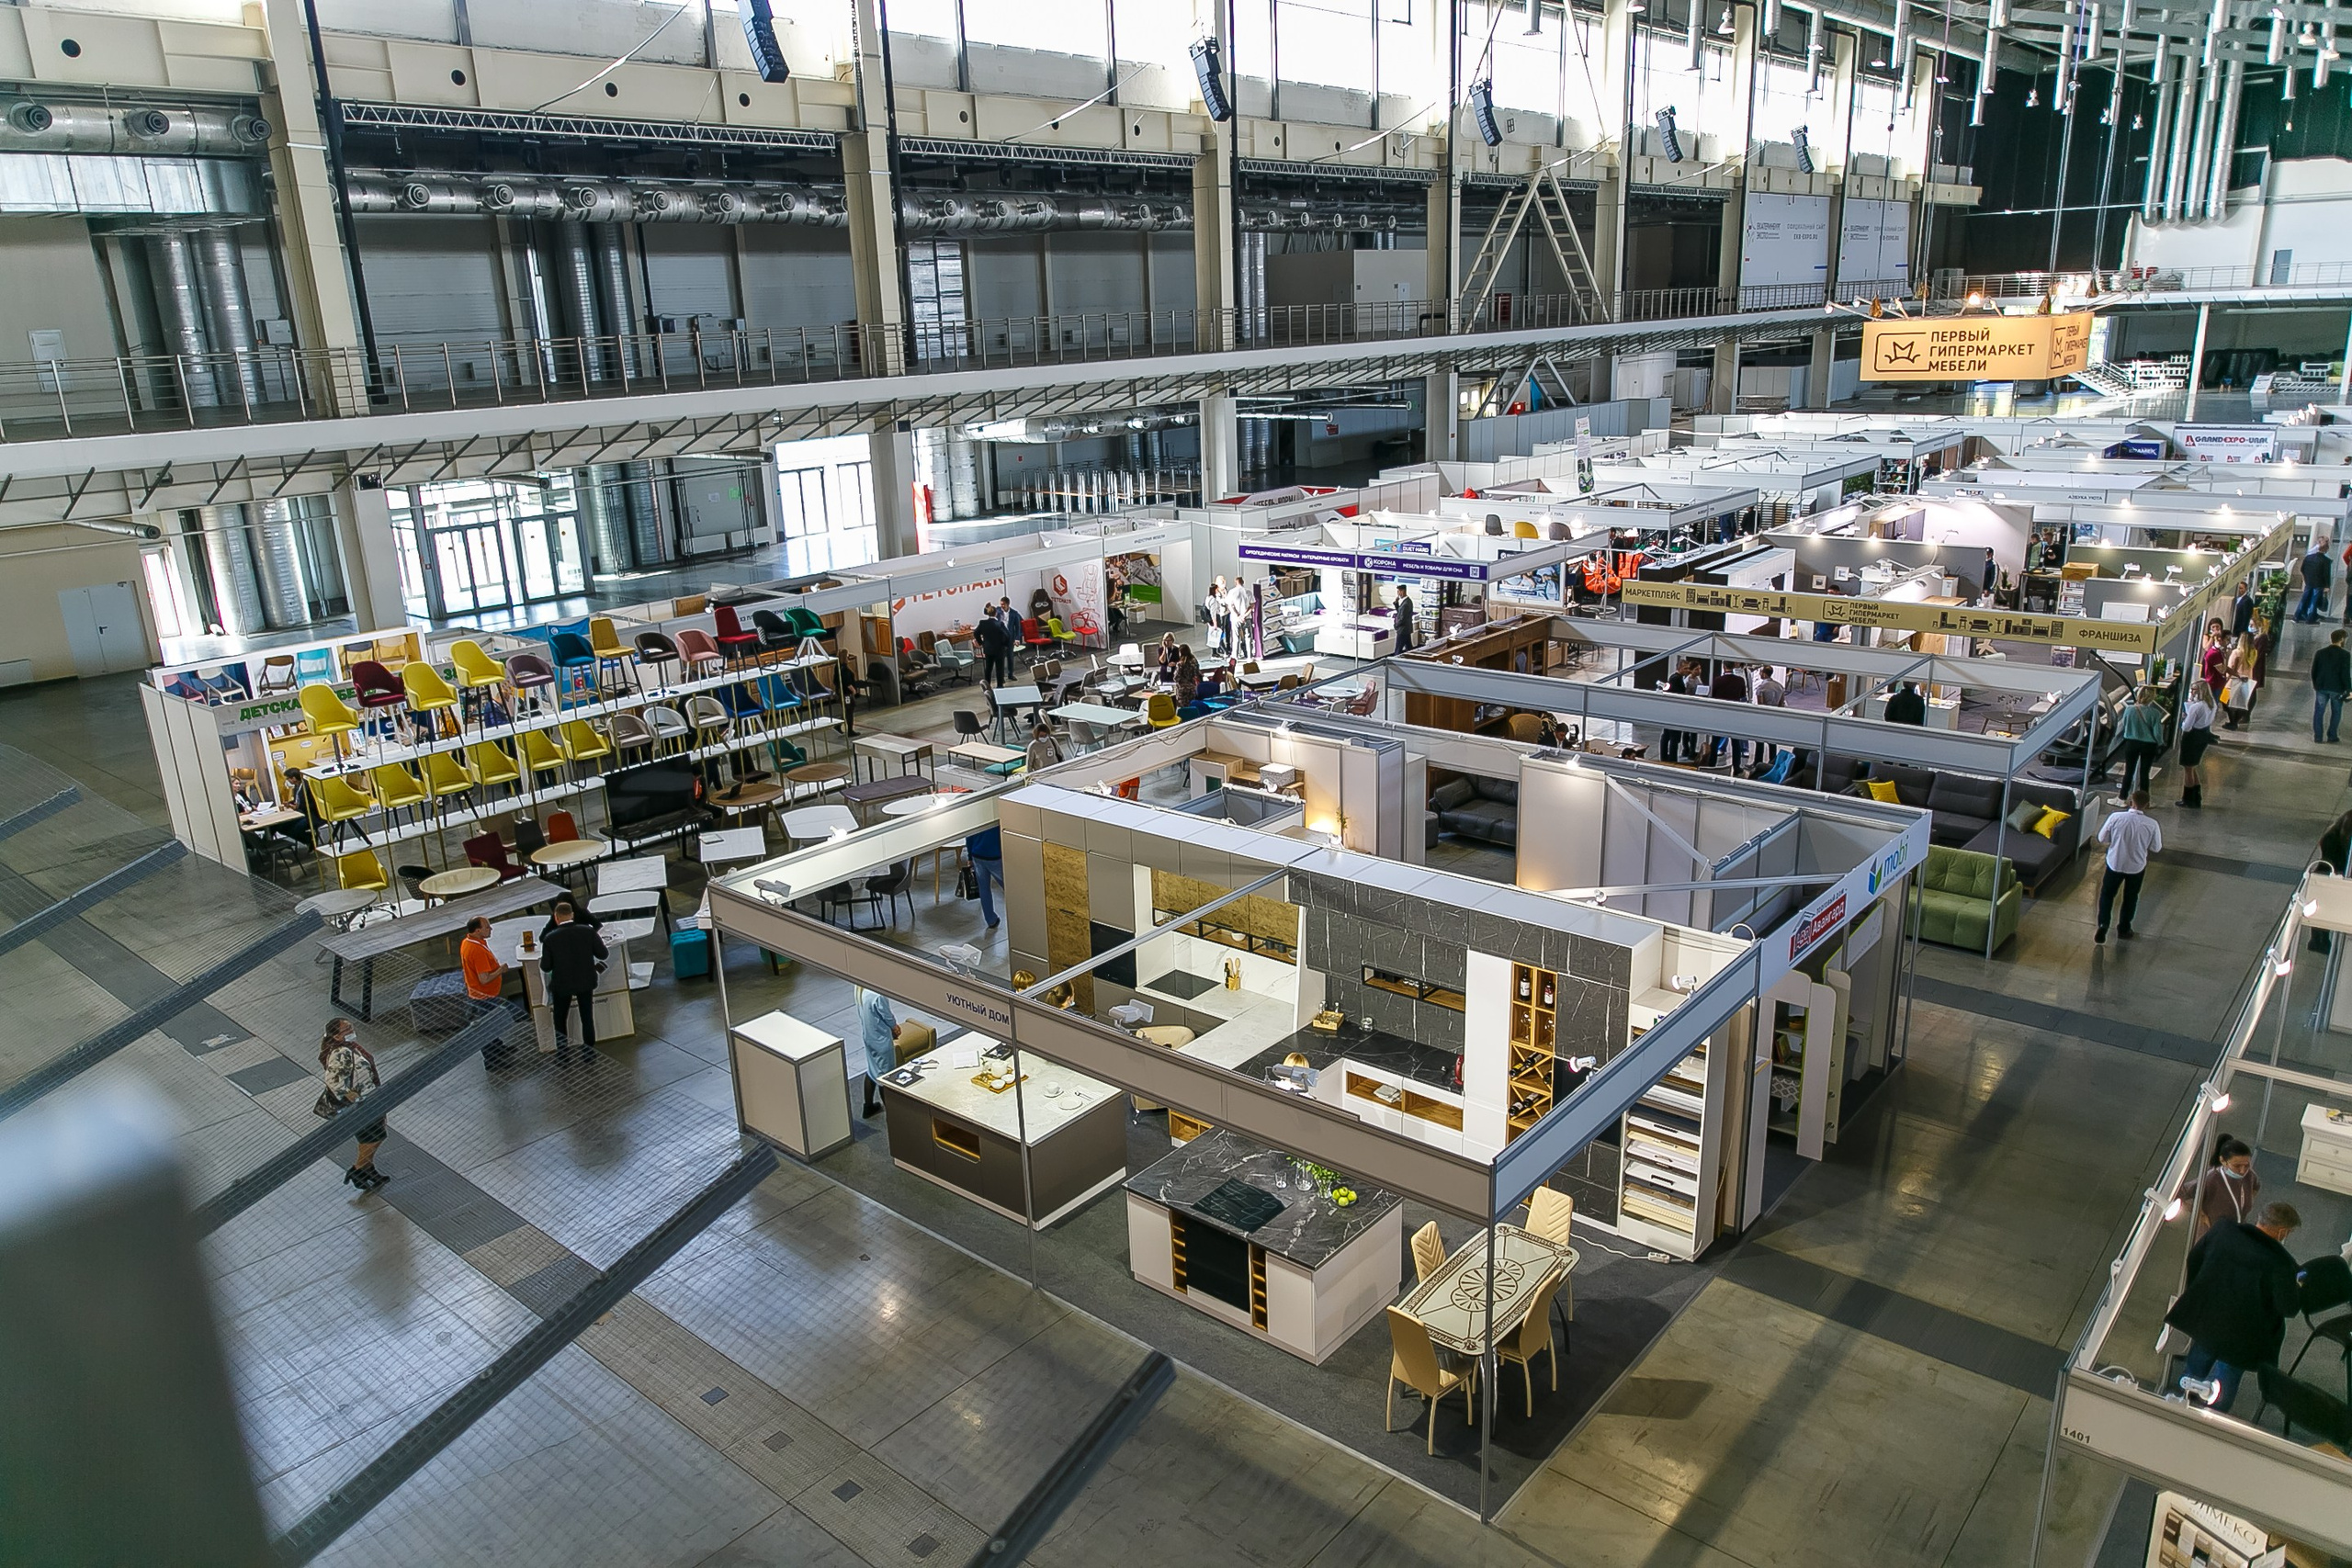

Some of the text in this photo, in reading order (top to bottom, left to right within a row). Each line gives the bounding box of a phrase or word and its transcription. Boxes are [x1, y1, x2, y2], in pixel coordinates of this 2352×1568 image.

[1930, 327, 1990, 343] ПЕРВЫЙ
[1929, 344, 2035, 357] ГИПЕРМАРКЕТ
[1929, 359, 1986, 371] МЕБЕЛИ
[1245, 549, 1281, 558] ОРТОПЕДИЧЕСКИЕ
[984, 566, 1002, 574] TETCHAIR
[1624, 587, 1681, 601] МАРКЕТПЛЕЙС
[1849, 602, 1879, 611] ПЕРВЫЙ
[1848, 615, 1878, 625] МЕБЕЛИ
[1849, 609, 1900, 620] ГИПЕРМАРКЕТ
[2078, 628, 2142, 644] ФРАНШИЗА
[240, 698, 301, 721] ДЕТСКА
[1883, 834, 1909, 878] mobi
[1811, 901, 1845, 937] Авангард
[946, 992, 1011, 1026] УЮТНЫЙ ДОМ
[2063, 1427, 2091, 1445] 1401
